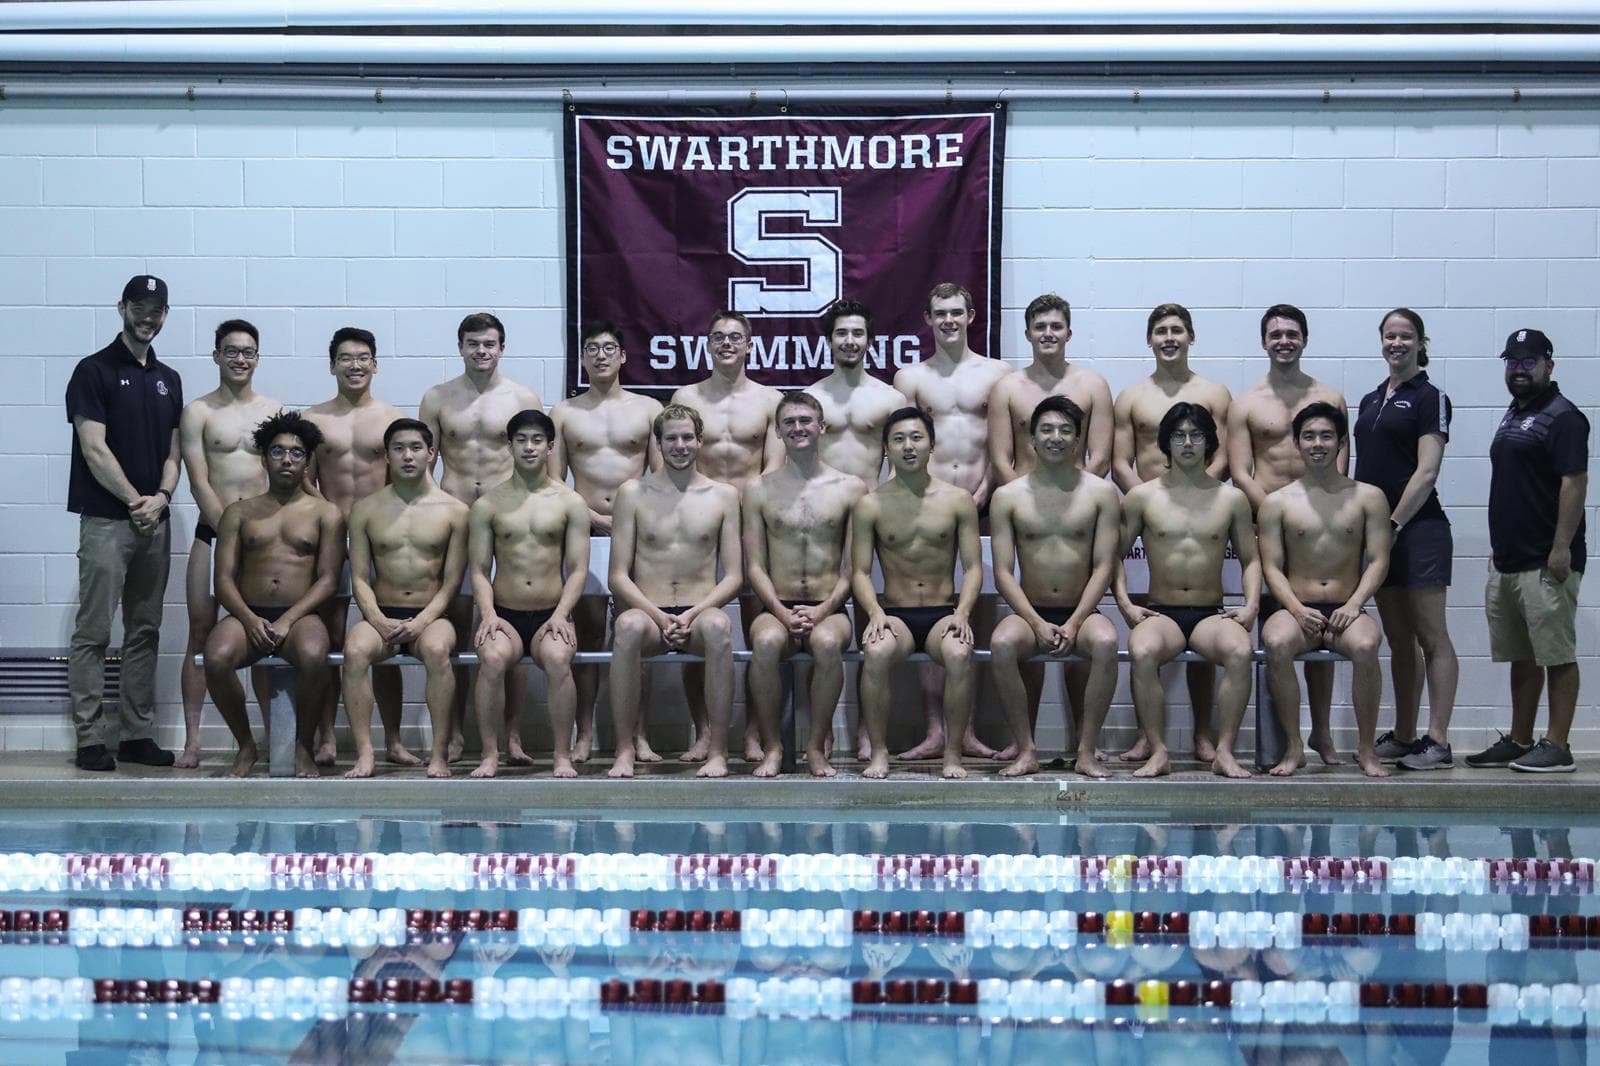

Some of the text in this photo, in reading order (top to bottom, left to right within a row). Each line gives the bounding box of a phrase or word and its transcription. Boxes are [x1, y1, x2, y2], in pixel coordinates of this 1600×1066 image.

[606, 133, 964, 171] SWARTHMORE
[727, 186, 843, 319] S
[649, 335, 921, 370] SWMMNG
